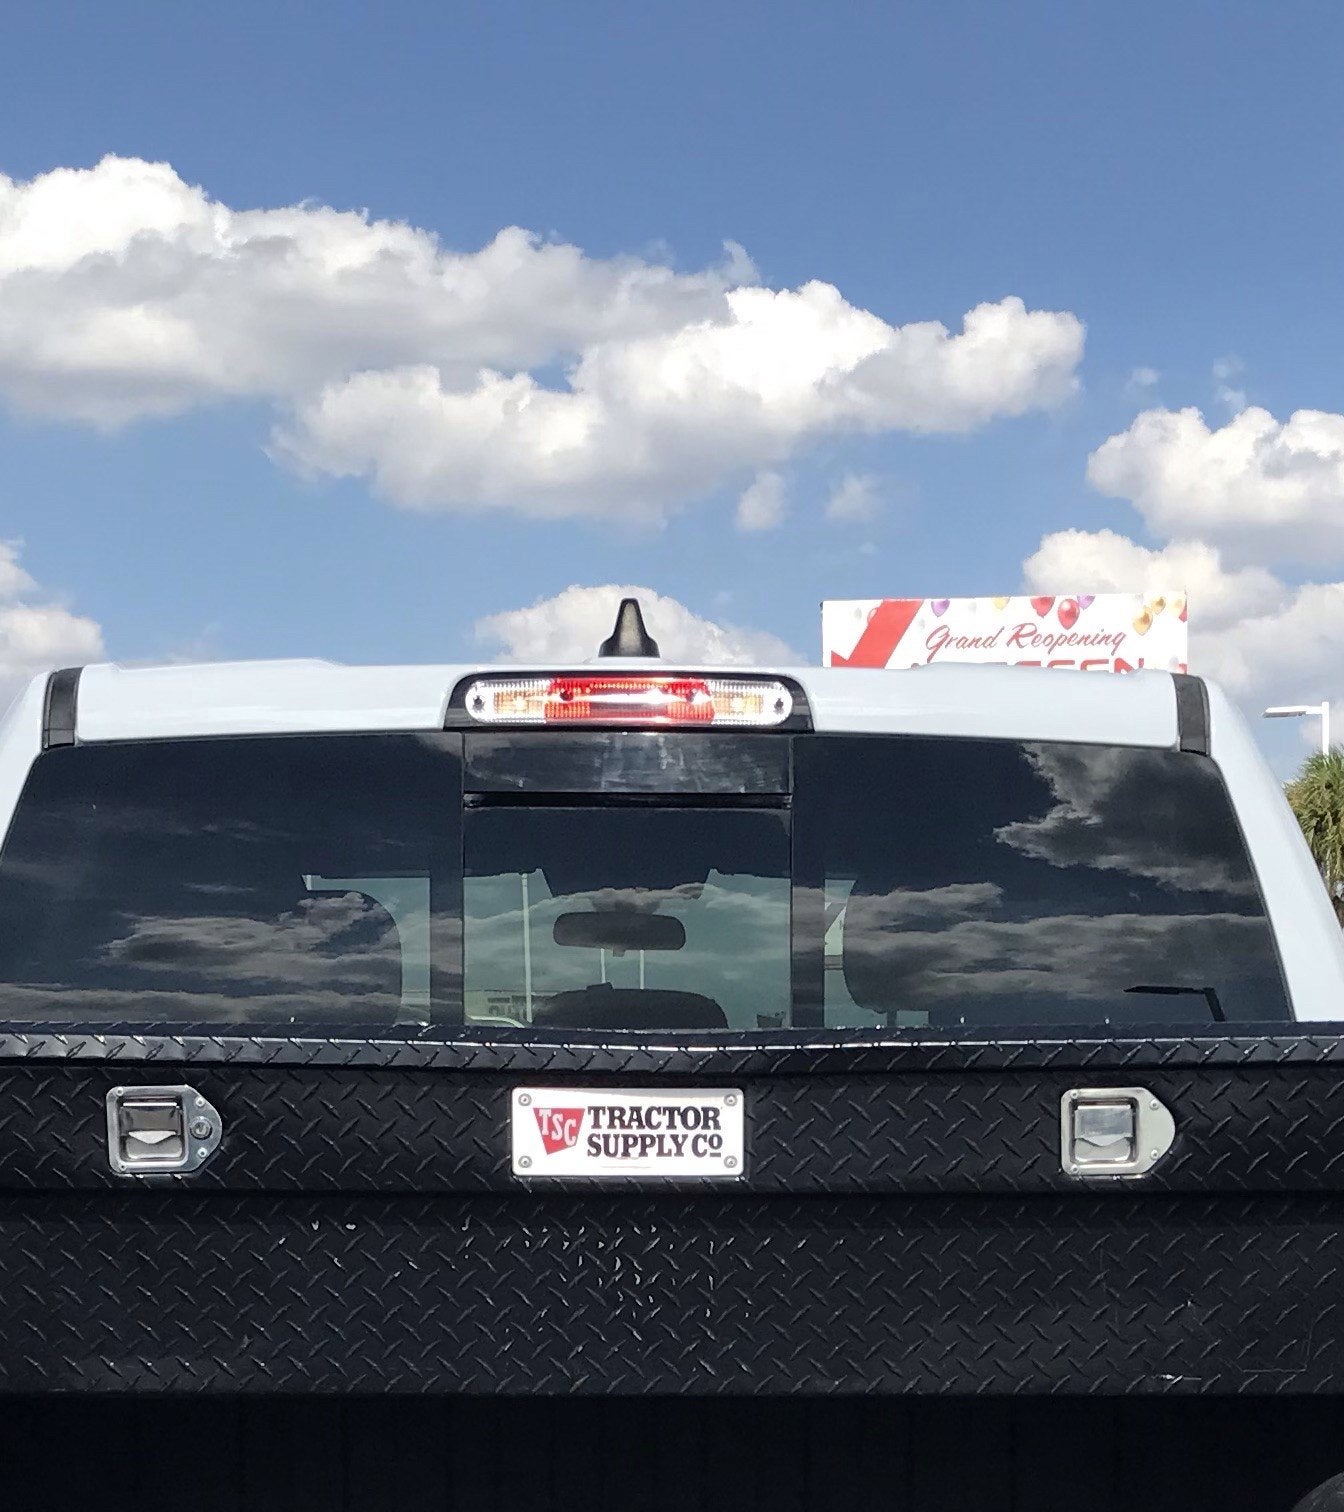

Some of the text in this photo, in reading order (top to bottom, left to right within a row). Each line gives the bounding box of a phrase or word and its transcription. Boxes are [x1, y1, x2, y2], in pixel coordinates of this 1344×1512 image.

[925, 622, 1126, 664] Grand Reopening
[538, 1108, 577, 1146] TSC
[587, 1106, 721, 1130] TRACTOR
[587, 1133, 688, 1158] SUPPLY
